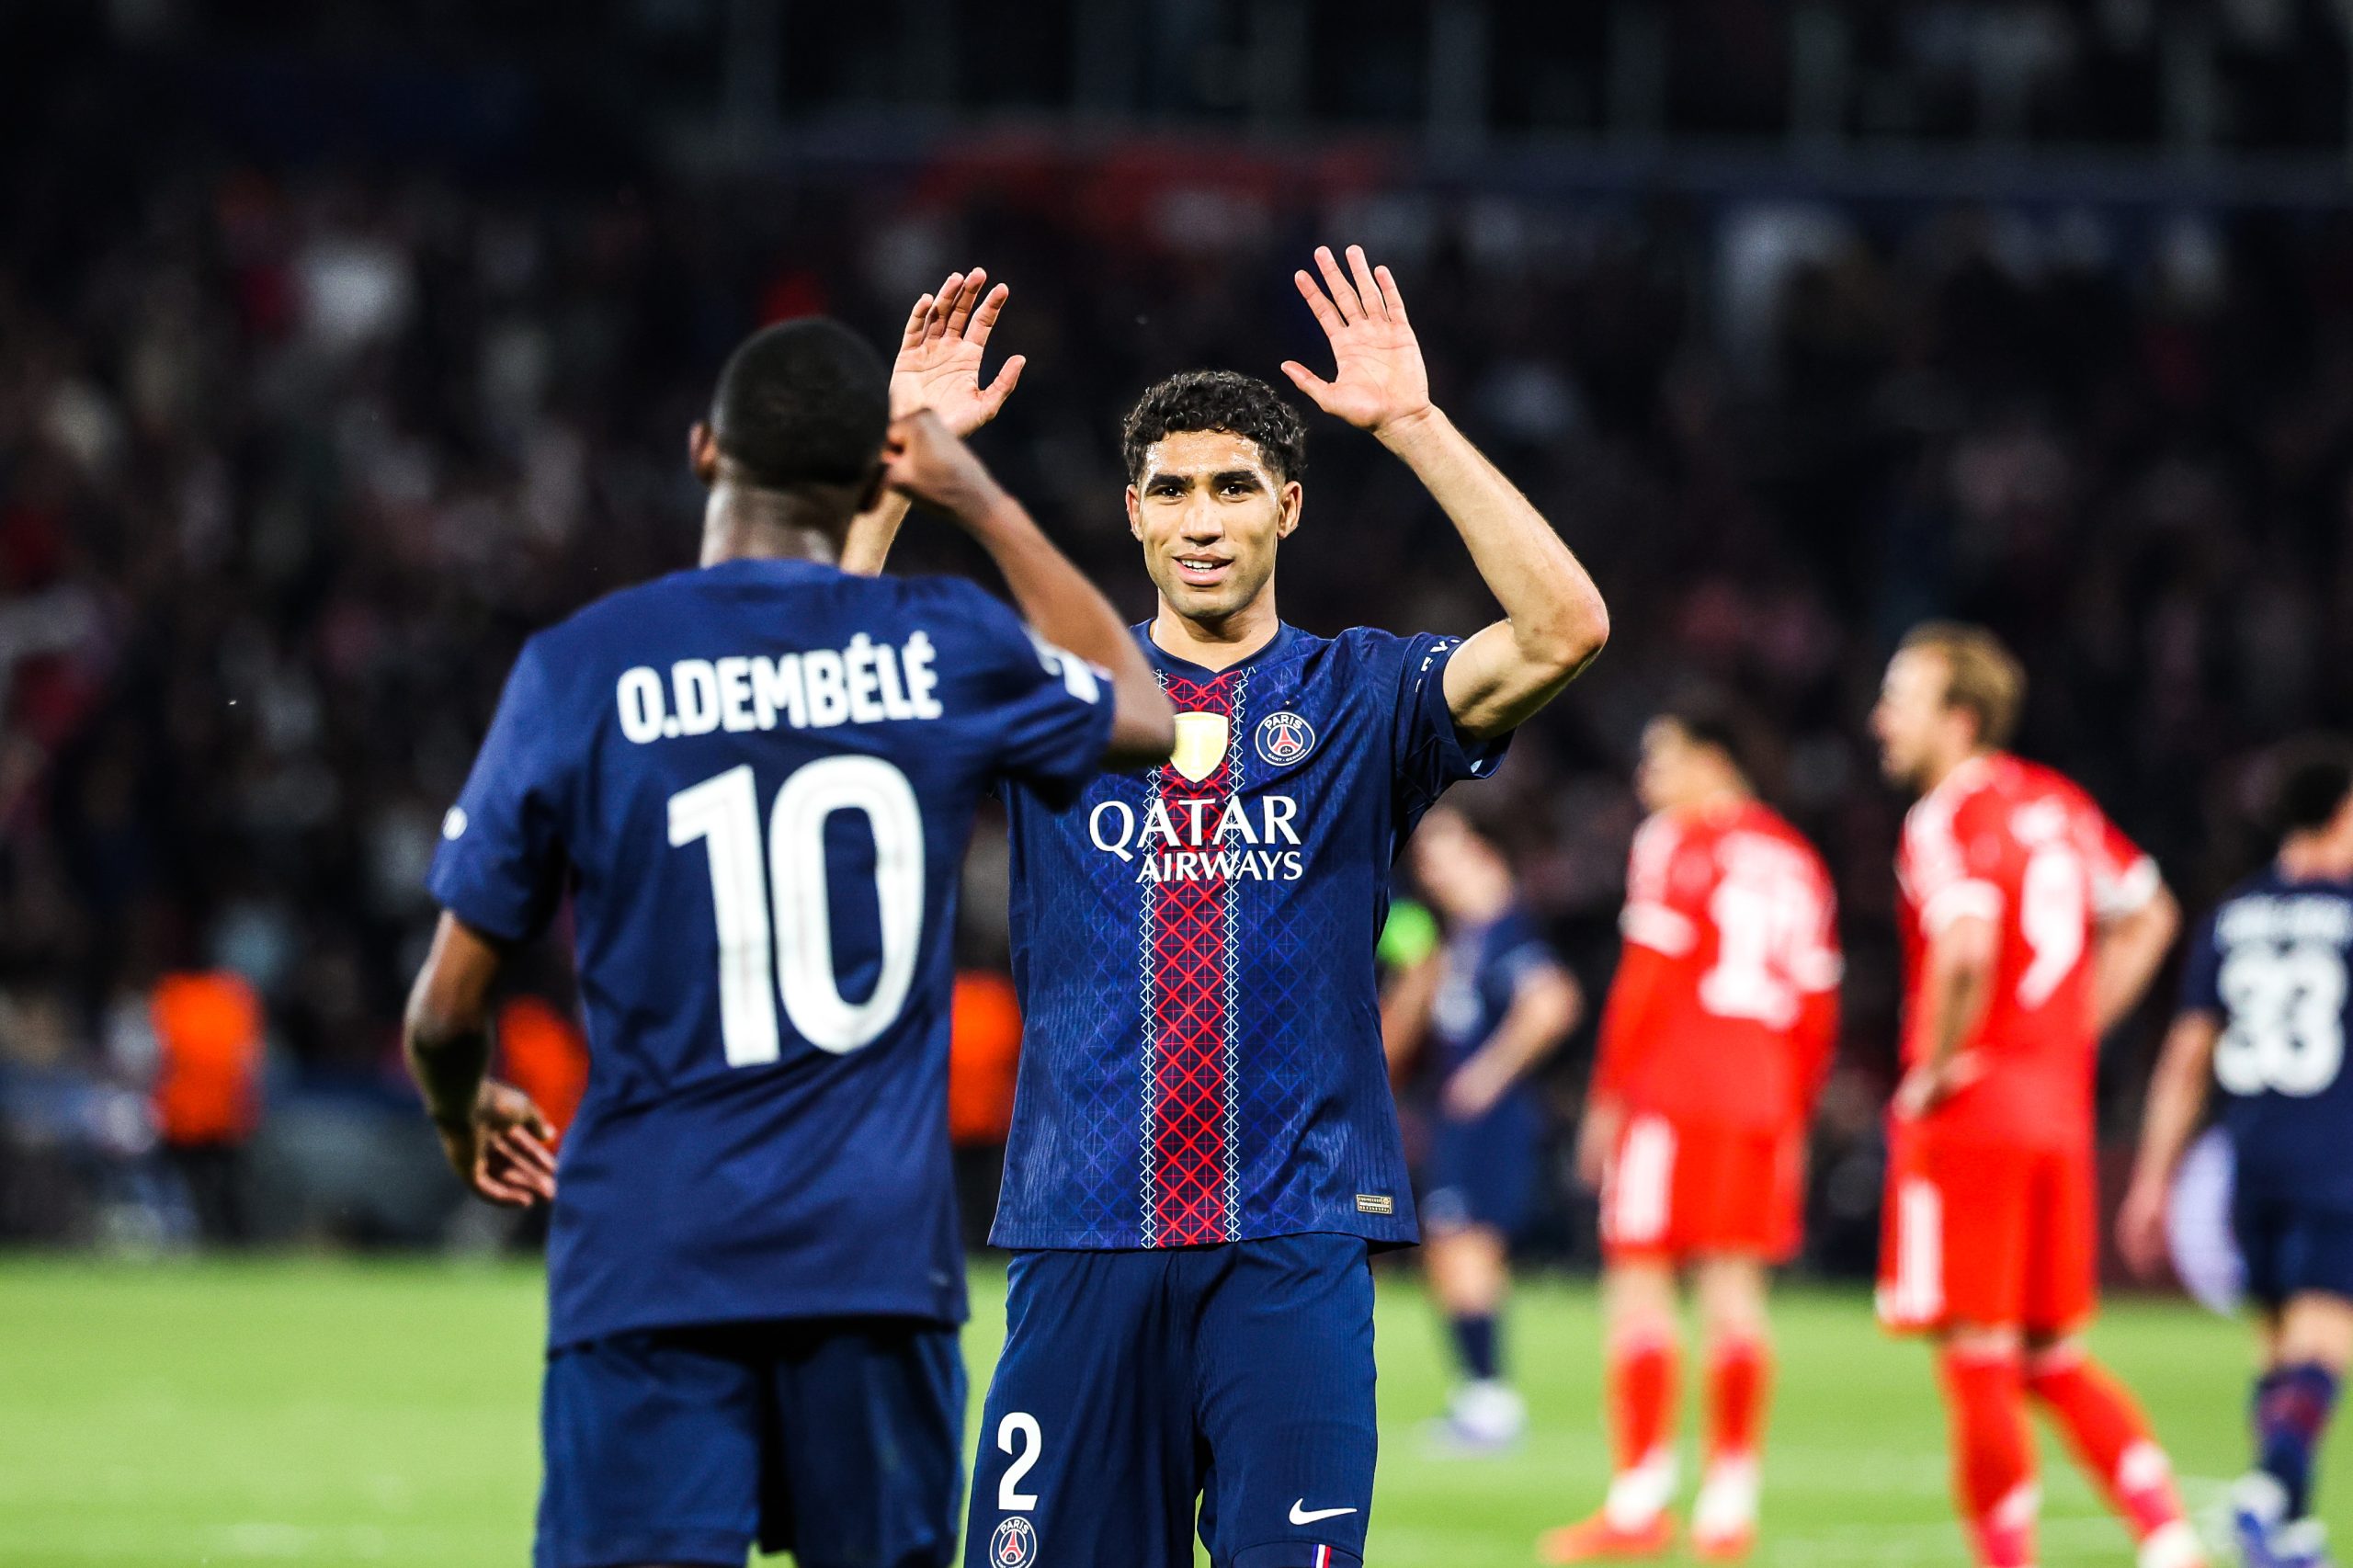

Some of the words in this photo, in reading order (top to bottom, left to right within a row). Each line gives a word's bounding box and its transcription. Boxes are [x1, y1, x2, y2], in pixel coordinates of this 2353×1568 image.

[1264, 714, 1303, 730] PARIS
[1089, 795, 1302, 863] QATAR
[1135, 849, 1303, 883] AIRWAYS
[667, 754, 926, 1068] 10
[2212, 950, 2349, 1097] 33
[997, 1411, 1042, 1511] 2
[1000, 1519, 1030, 1535] PARIS
